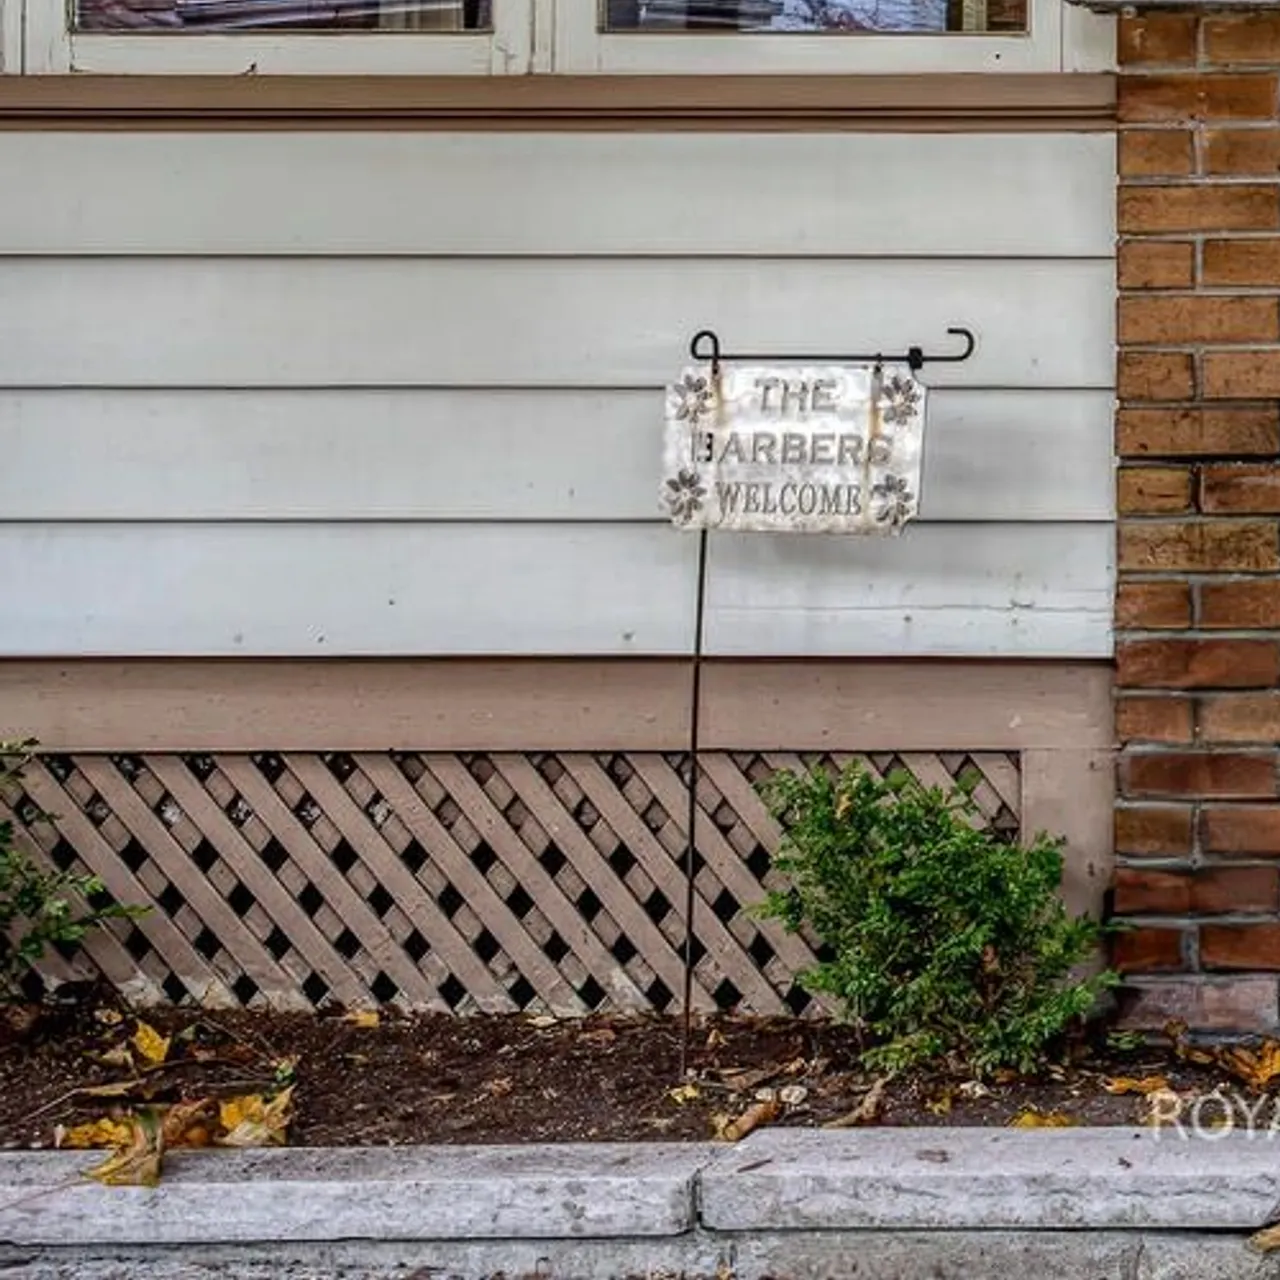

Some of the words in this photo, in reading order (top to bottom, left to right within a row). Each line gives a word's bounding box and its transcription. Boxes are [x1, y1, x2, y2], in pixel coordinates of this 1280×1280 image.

[755, 377, 837, 414] THE
[690, 431, 893, 466] BARBERS
[715, 480, 862, 518] WELCOME
